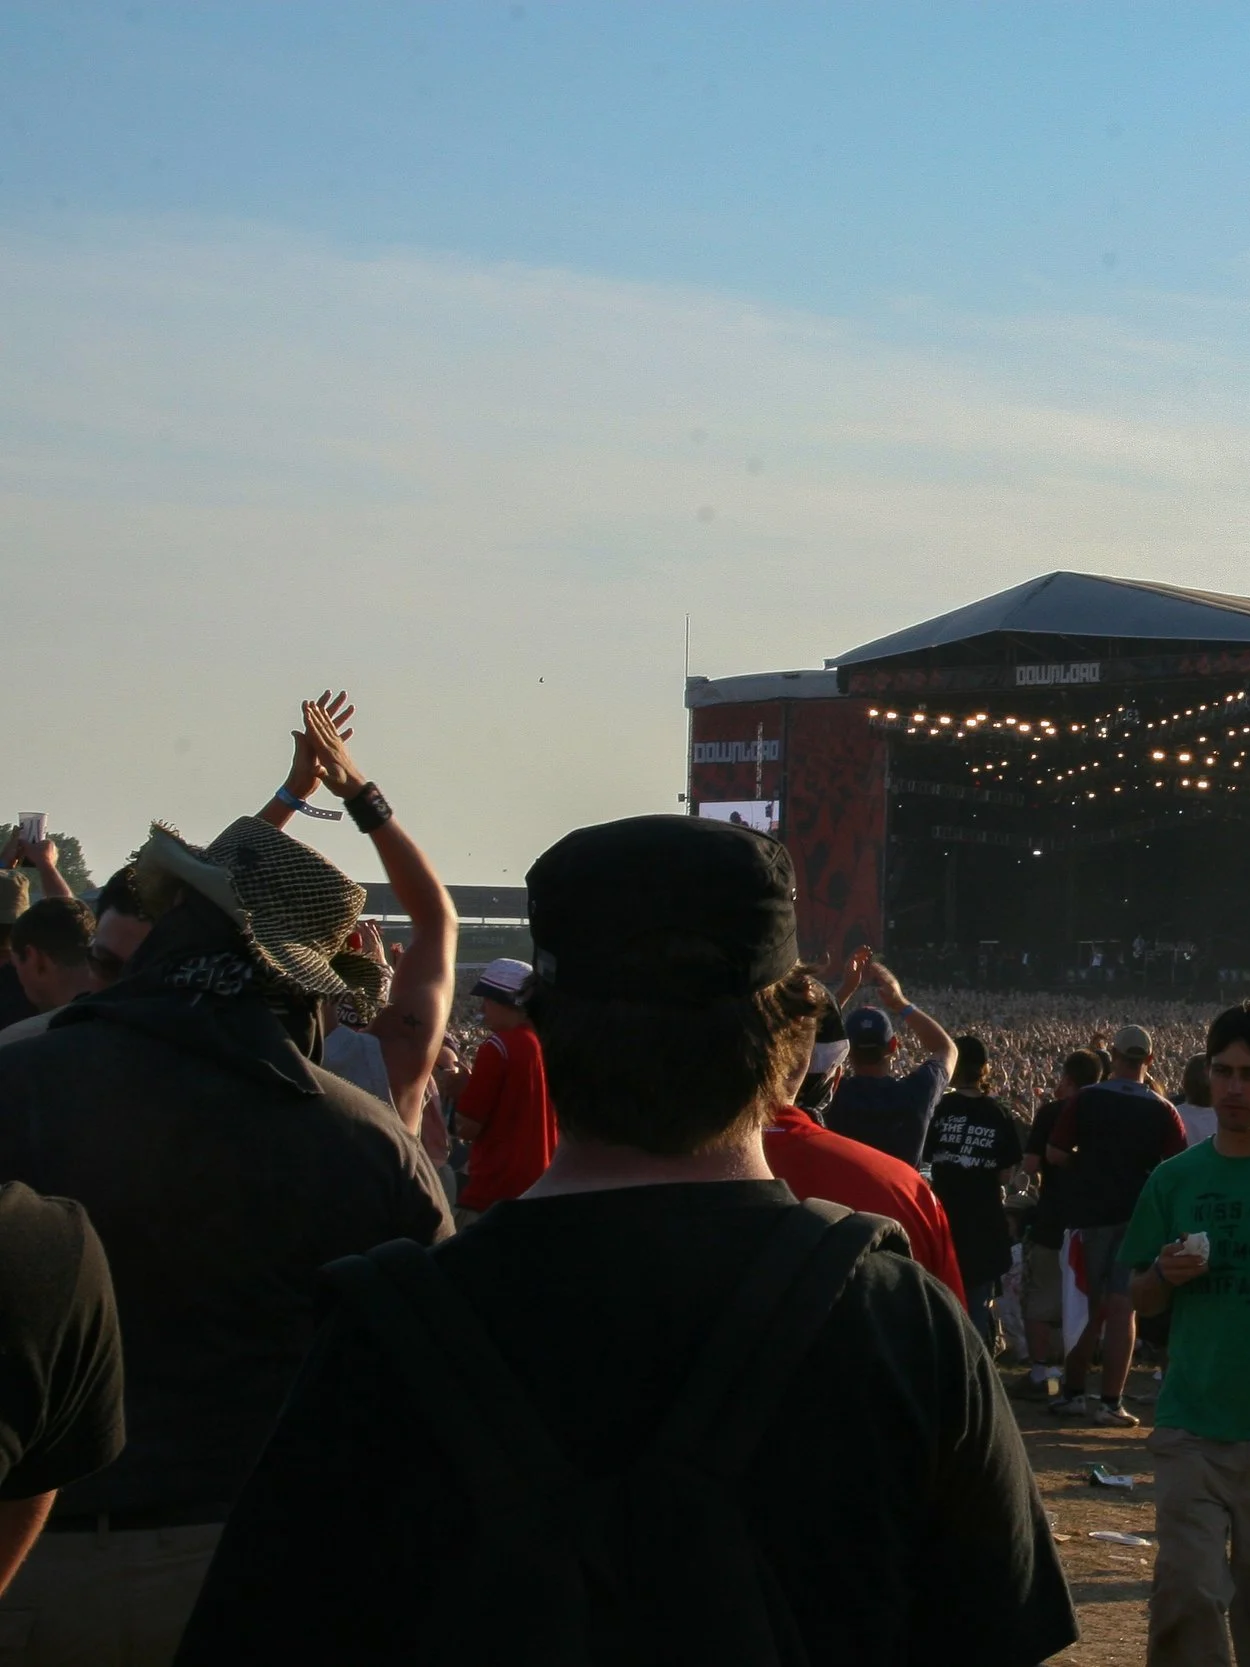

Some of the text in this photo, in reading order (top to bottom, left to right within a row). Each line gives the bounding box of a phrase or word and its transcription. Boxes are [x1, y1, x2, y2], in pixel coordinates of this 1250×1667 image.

[1015, 662, 1101, 687] DOWNLOAD
[693, 740, 780, 764] DOWNLOAD
[942, 1122, 996, 1138] THE BOYS
[940, 1134, 995, 1148] ARE BACK
[960, 1145, 973, 1155] IN
[1194, 1201, 1243, 1222] KISS
